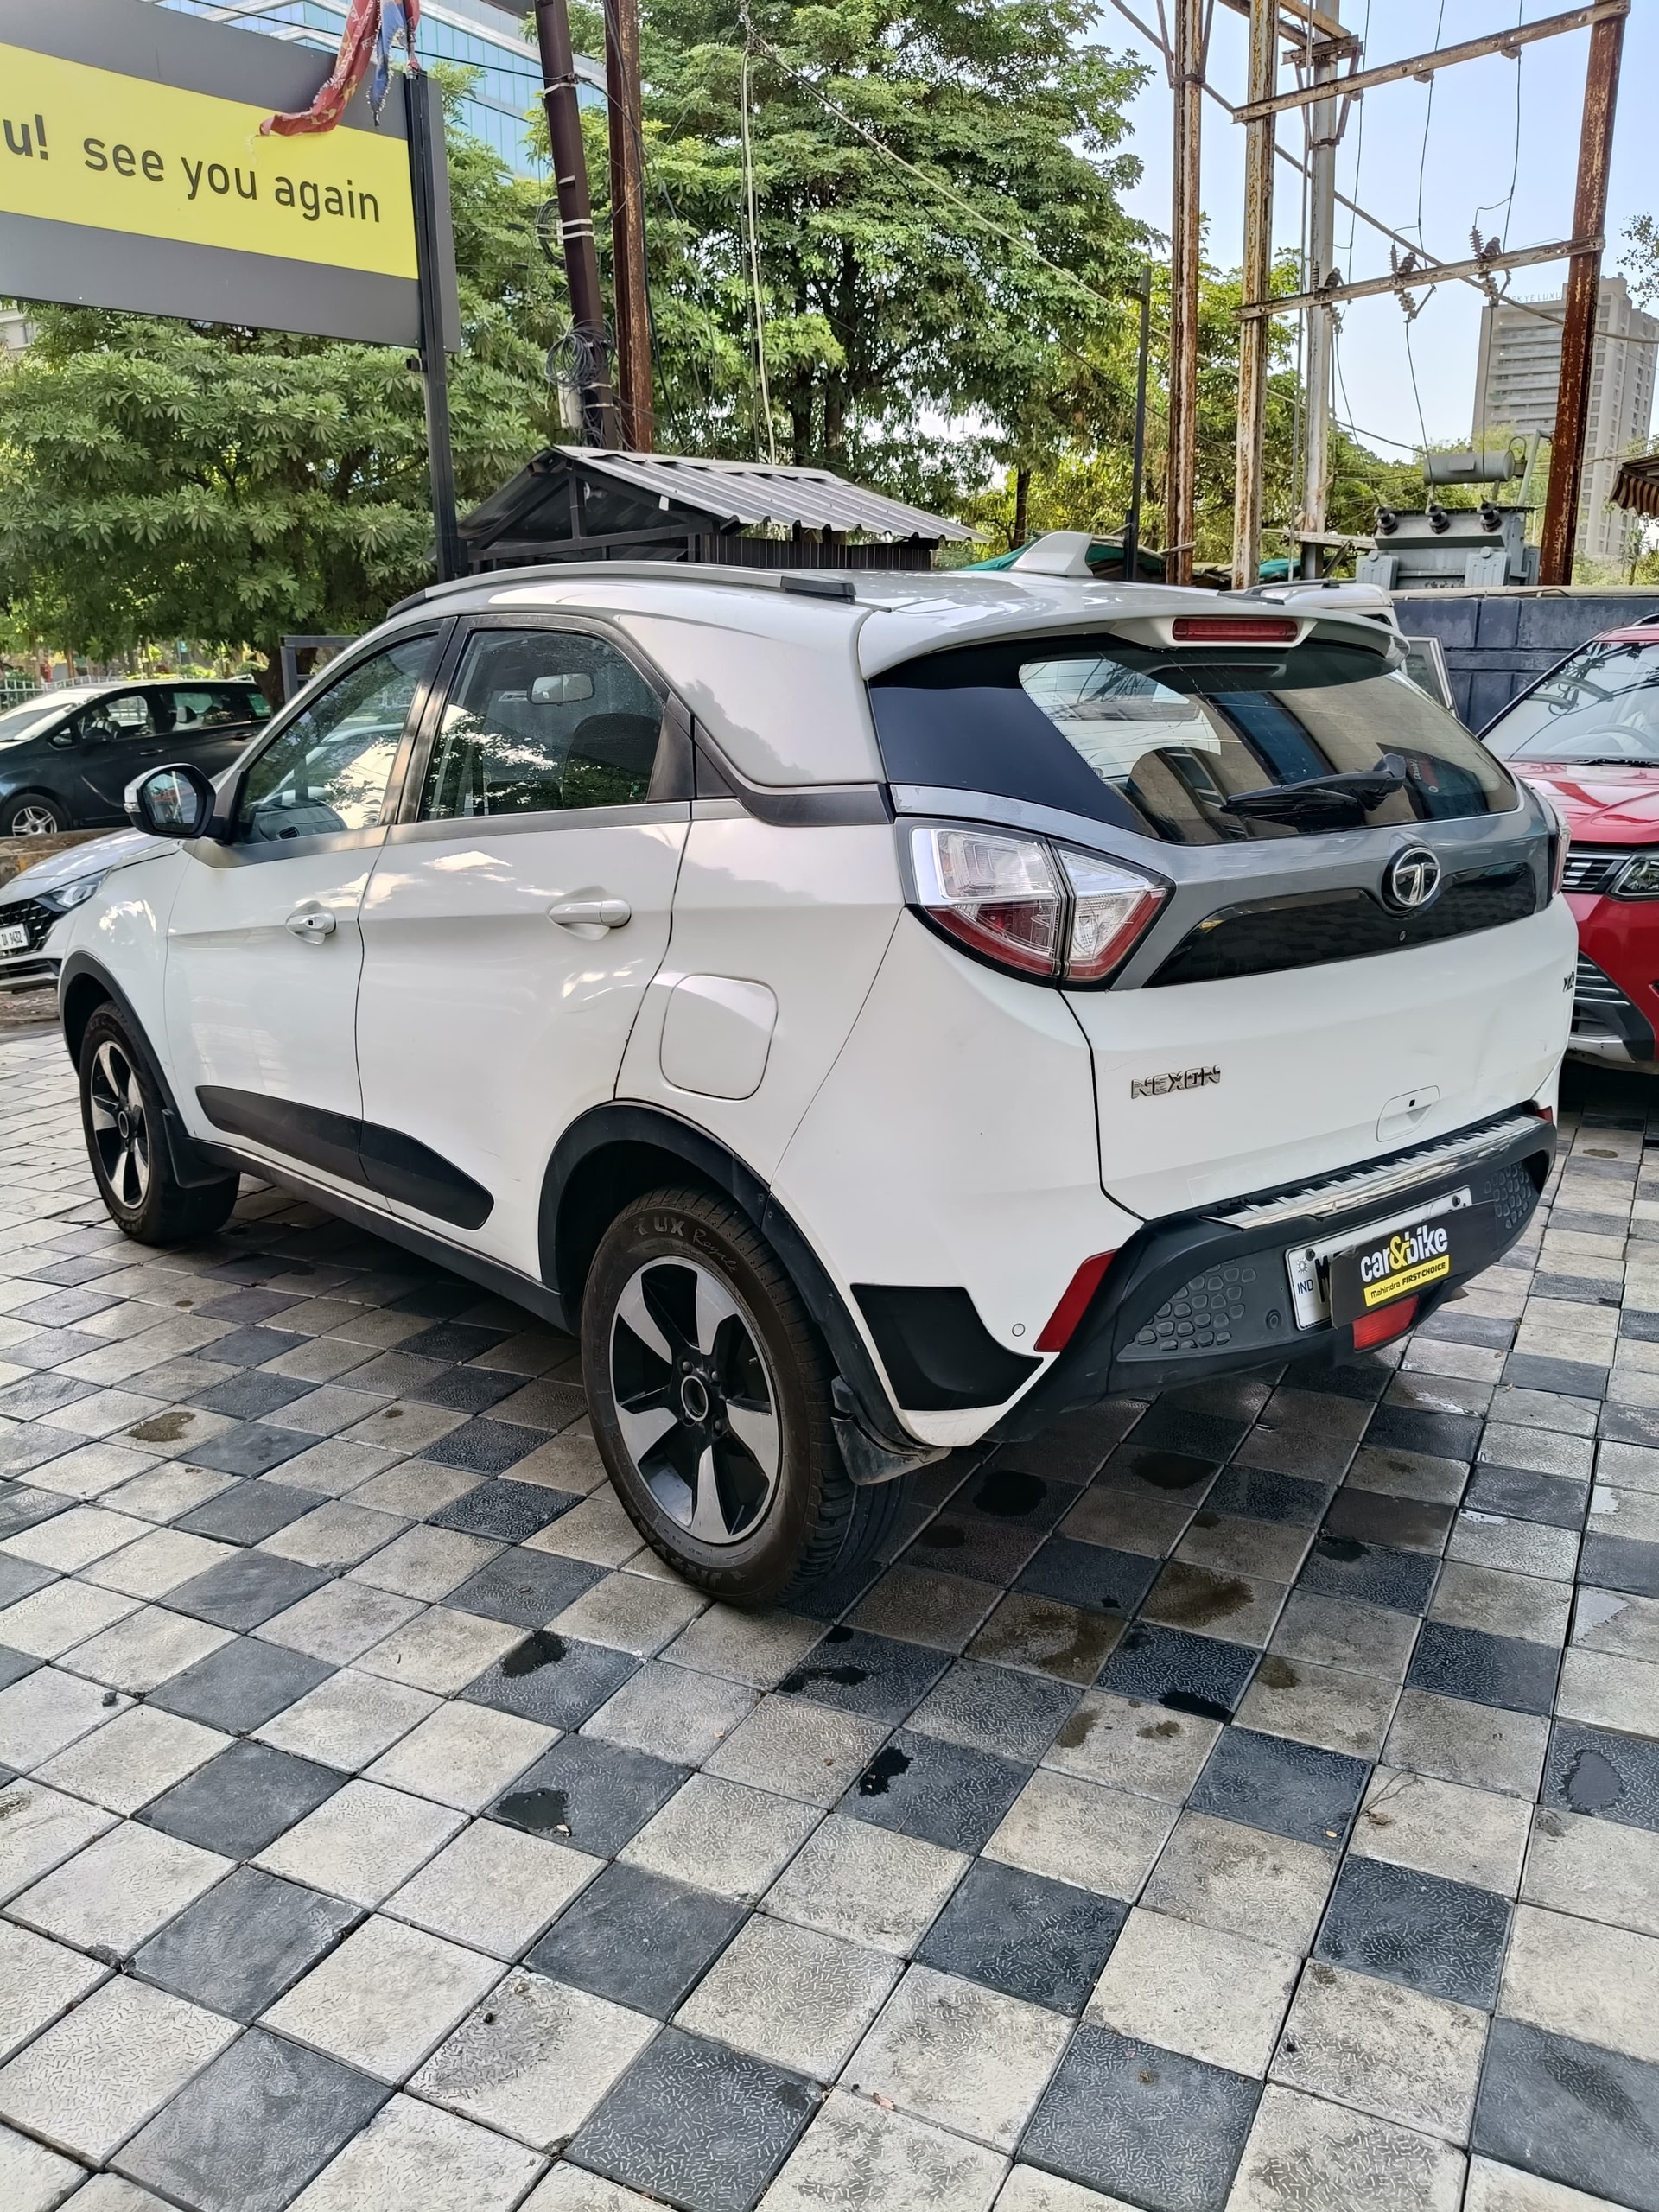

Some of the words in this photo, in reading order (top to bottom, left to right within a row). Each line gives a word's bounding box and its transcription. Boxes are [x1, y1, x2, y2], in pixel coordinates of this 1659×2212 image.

[84, 137, 164, 182] see
[181, 156, 258, 200] you
[274, 176, 381, 223] again
[1130, 1064, 1221, 1100] NEXON
[1361, 1224, 1449, 1283] car&bike
[1297, 1278, 1314, 1296] IND
[1370, 1281, 1401, 1300] Mahindra
[1402, 1270, 1421, 1286] FIRST
[1421, 1261, 1446, 1277] CHOICE
